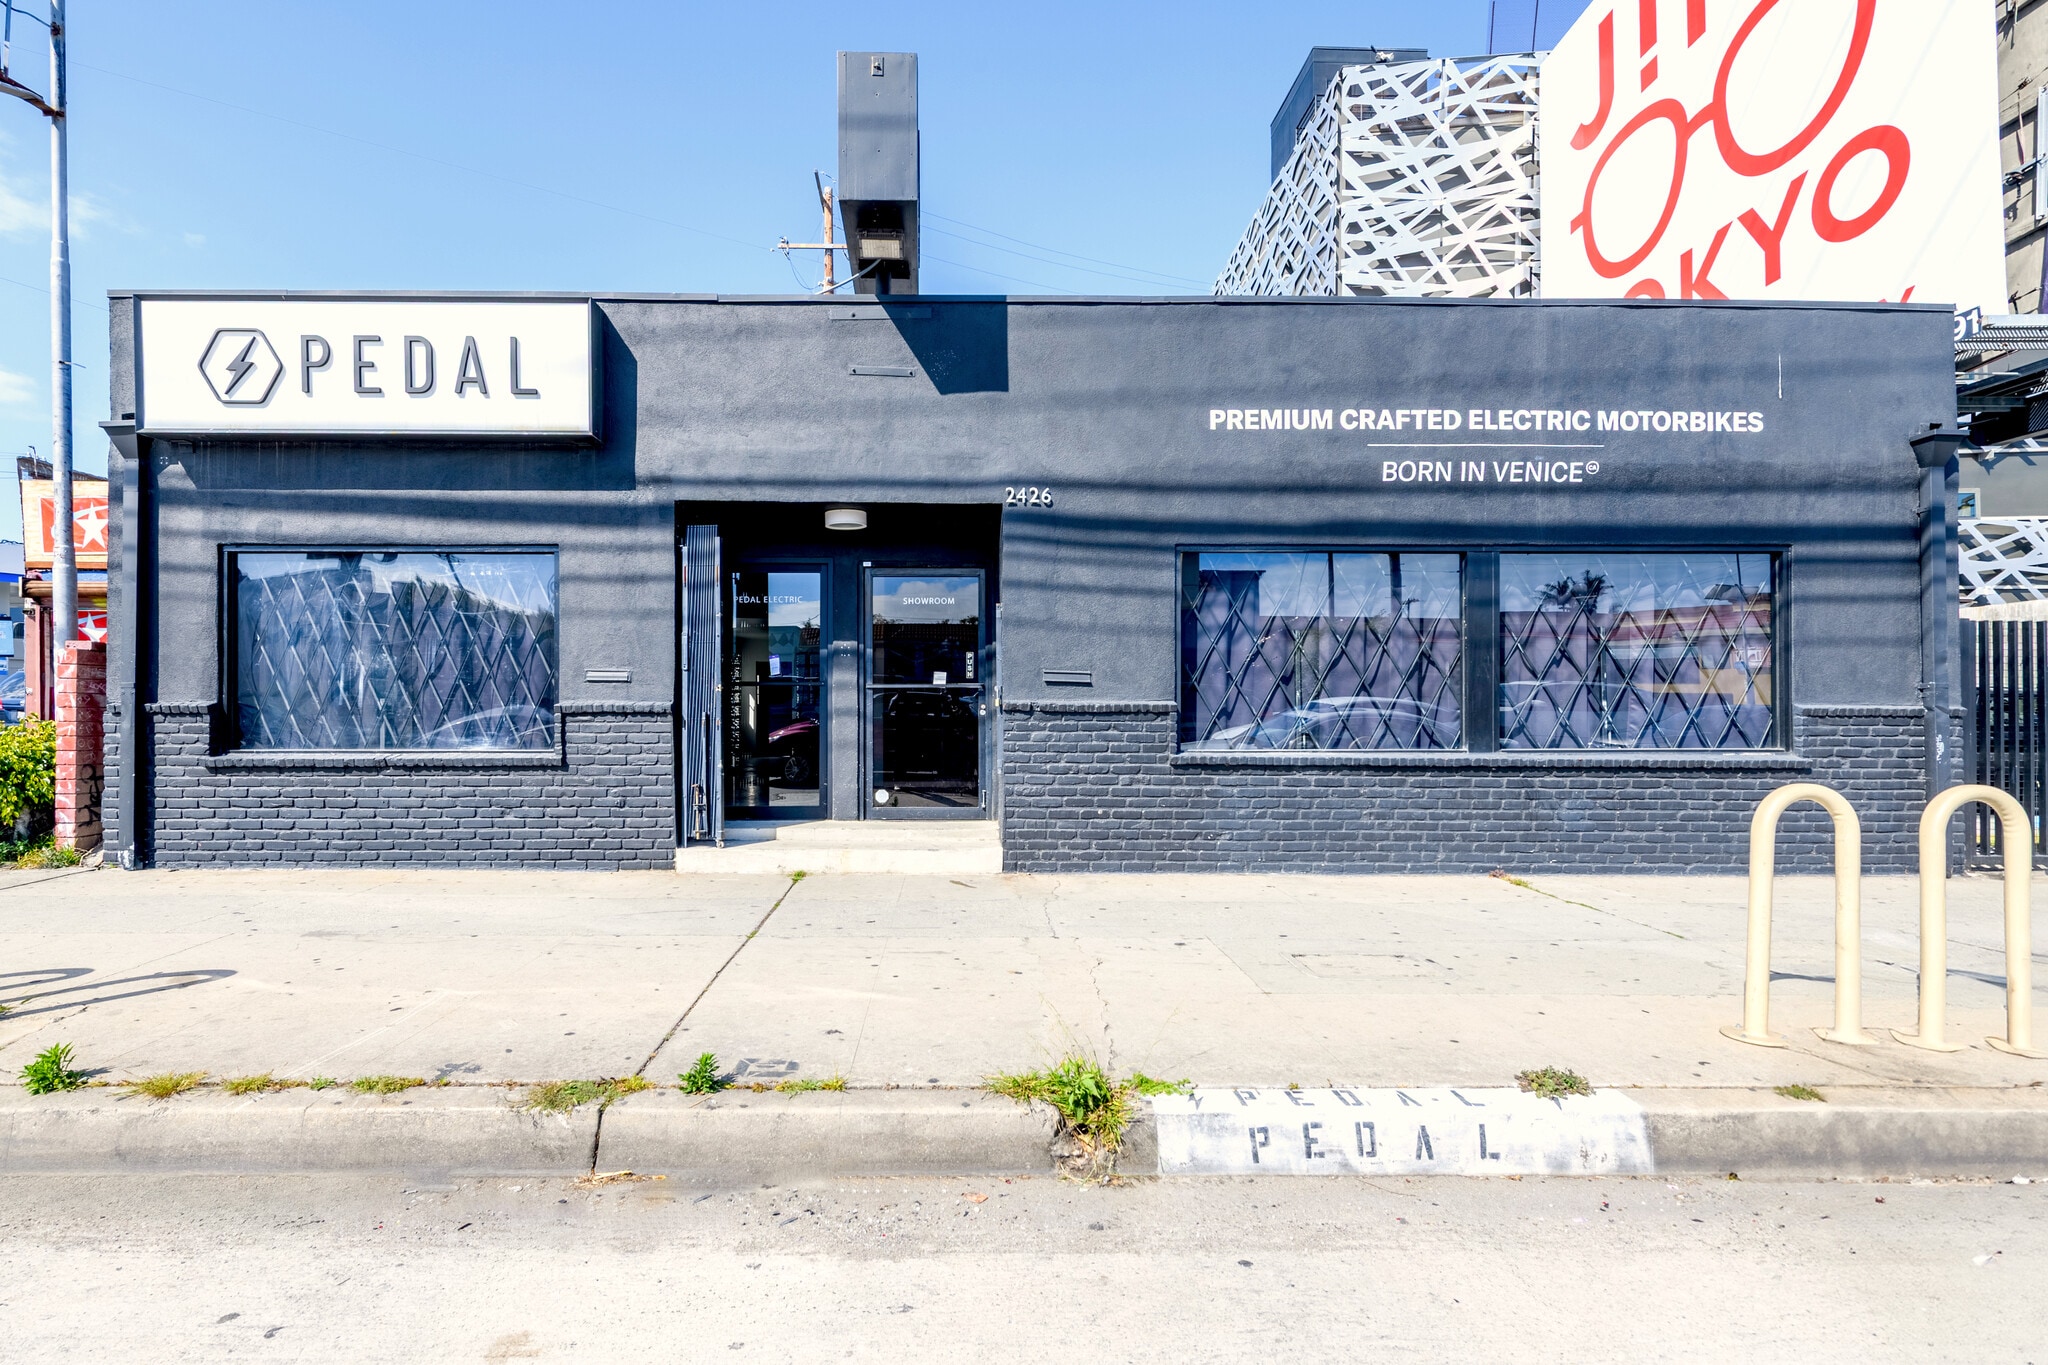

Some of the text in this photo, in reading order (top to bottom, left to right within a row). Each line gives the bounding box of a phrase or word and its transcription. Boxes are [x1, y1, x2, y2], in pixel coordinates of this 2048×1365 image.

[300, 335, 540, 395] PEDAL
[1208, 409, 1766, 433] PREMIUM CRAFTED ELECTRIC MOTORBIKES
[1381, 460, 1453, 482] BORN
[1460, 461, 1486, 482] IN
[1492, 461, 1584, 482] VENICE
[1005, 487, 1052, 503] 2426
[734, 595, 803, 604] PEDAL ELECTRIC
[902, 596, 956, 606] SHOWROOM
[966, 652, 975, 679] PUSH
[1248, 1120, 1502, 1164] PEDAL
